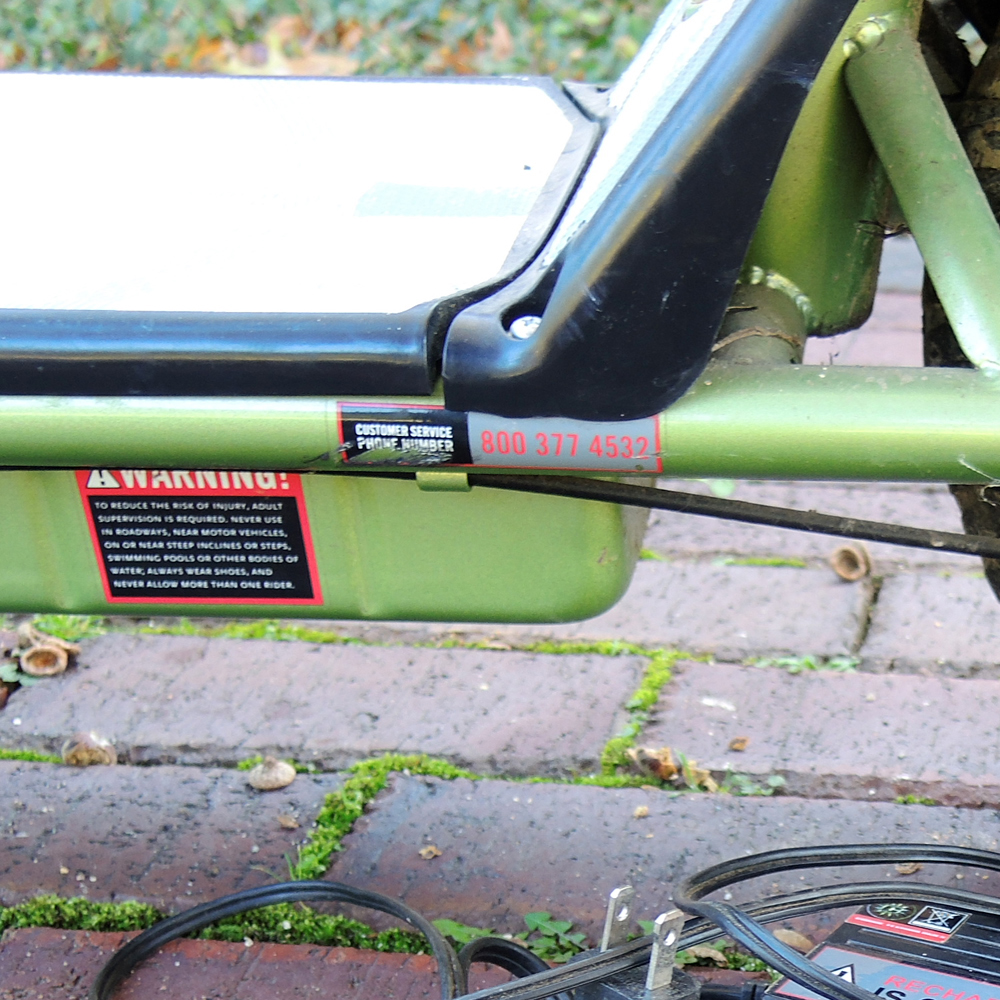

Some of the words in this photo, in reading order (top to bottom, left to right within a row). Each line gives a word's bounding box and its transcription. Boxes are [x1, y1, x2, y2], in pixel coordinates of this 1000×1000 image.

[355, 423, 409, 437] CUSTOMER
[409, 425, 454, 438] SERVICE
[401, 438, 454, 453] NUMBER
[481, 430, 527, 455] 800
[535, 432, 579, 457] 377
[589, 435, 650, 459] 4532
[120, 470, 290, 490] WARNING!
[94, 502, 109, 510] TO
[110, 502, 148, 510] REDUCE
[150, 502, 170, 510] THE
[172, 502, 194, 510] RISK
[212, 503, 250, 511] INJURY,
[252, 503, 283, 511] ADULT
[98, 515, 162, 523] SUPERVISION
[164, 515, 174, 523] IS
[176, 515, 229, 524] REQUIRED.
[264, 516, 283, 524] USE
[101, 528, 113, 536] IN
[115, 528, 171, 537] ROADWAYS,
[173, 528, 199, 536] NEAR
[201, 528, 237, 536] MOTOR
[238, 529, 288, 538] VEHICLES,
[104, 541, 120, 549] ON
[122, 541, 137, 549] OR
[138, 541, 164, 549] NEAR
[166, 541, 194, 549] STEEP
[196, 542, 242, 550] INCLINES
[243, 542, 258, 550] OR
[260, 542, 292, 551] STEPS,
[107, 554, 162, 562] SWIMMING
[163, 554, 195, 562] POOLS
[197, 554, 211, 562] OR
[213, 554, 246, 562] OTHER
[248, 555, 284, 563] BODIES
[285, 555, 299, 563] OF
[147, 567, 184, 575] ALWAYS
[185, 567, 212, 576] WEAR
[214, 567, 250, 576] SHOES,
[251, 568, 273, 576] AND
[113, 580, 144, 588] NEVER
[146, 580, 178, 588] ALLOW
[180, 580, 208, 588] MORE
[211, 580, 238, 588] THAN
[263, 581, 295, 589] RIDER.
